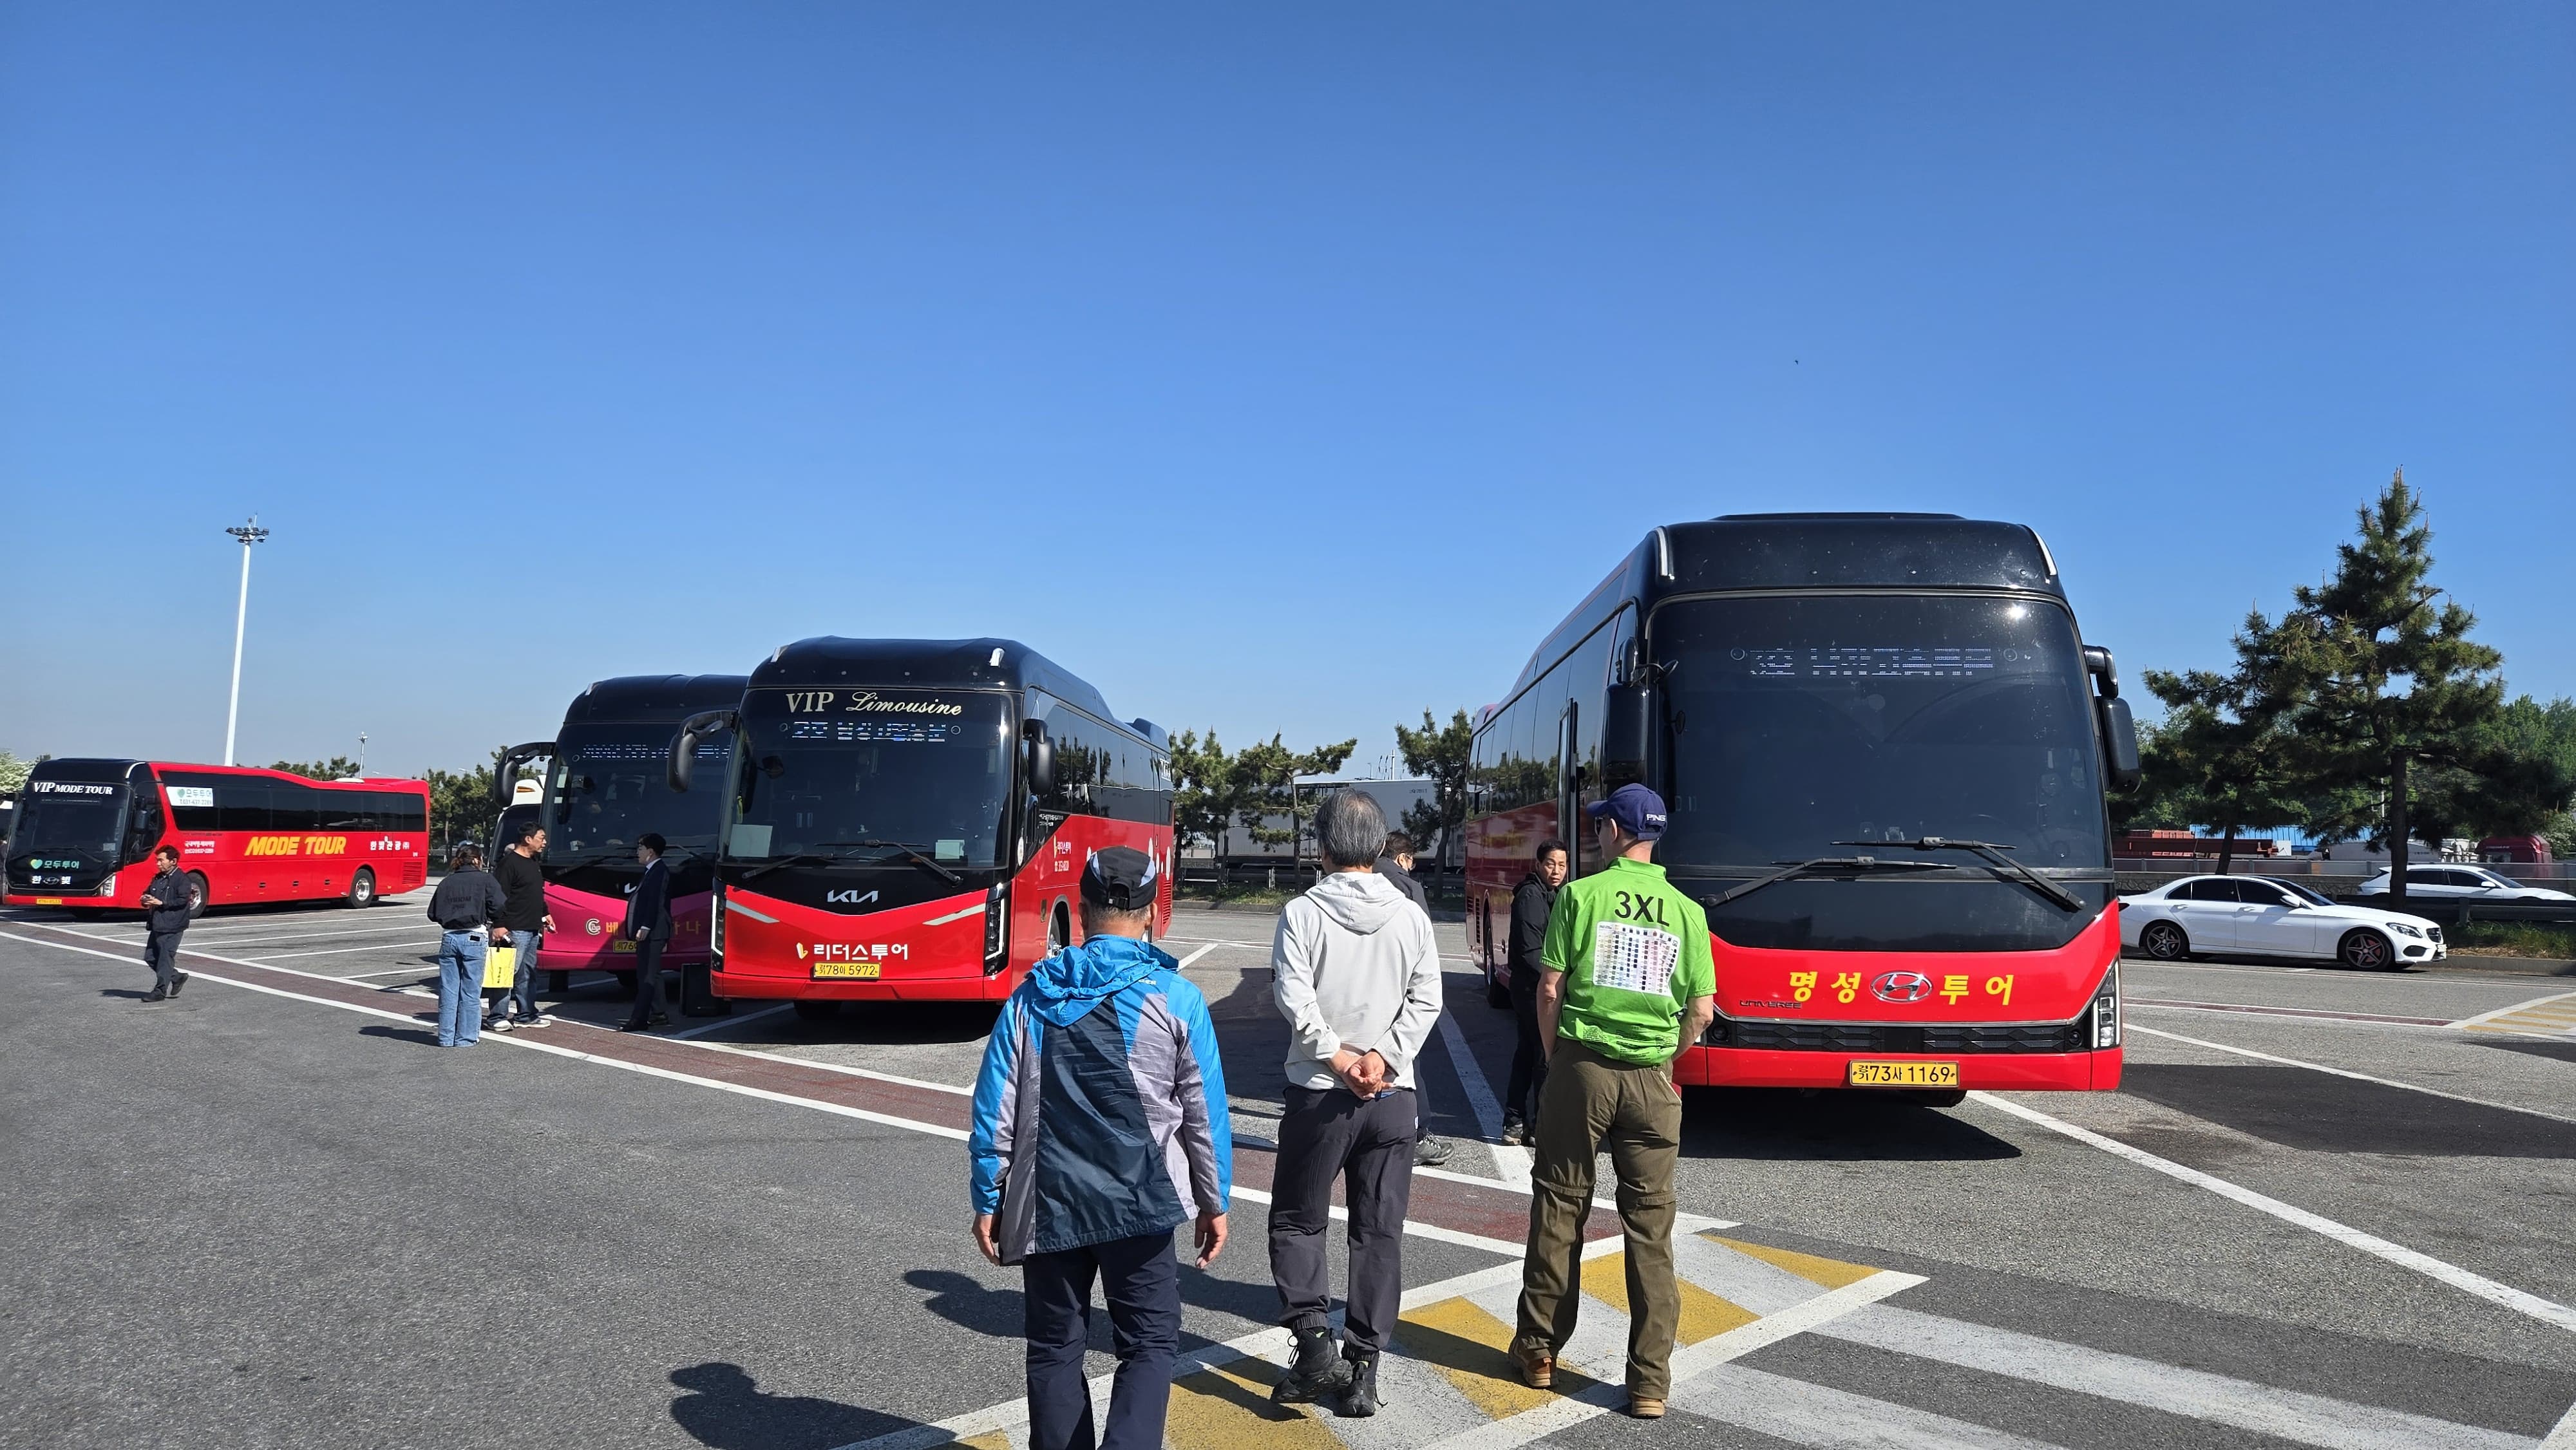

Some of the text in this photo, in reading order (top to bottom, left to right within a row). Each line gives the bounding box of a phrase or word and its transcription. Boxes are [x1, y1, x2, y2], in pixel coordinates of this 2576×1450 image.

[786, 692, 962, 715] VIP Limousine
[34, 782, 55, 793] VIP
[85, 786, 113, 795] TOUR
[244, 836, 346, 856] MODE TOUR
[44, 860, 79, 869] 모두투어
[1615, 890, 1669, 927] 3XL
[813, 944, 908, 961] 리더스투어
[849, 965, 876, 975] 5972
[1789, 971, 2014, 1006] 명성 투어
[1909, 1066, 1949, 1082] 1169
